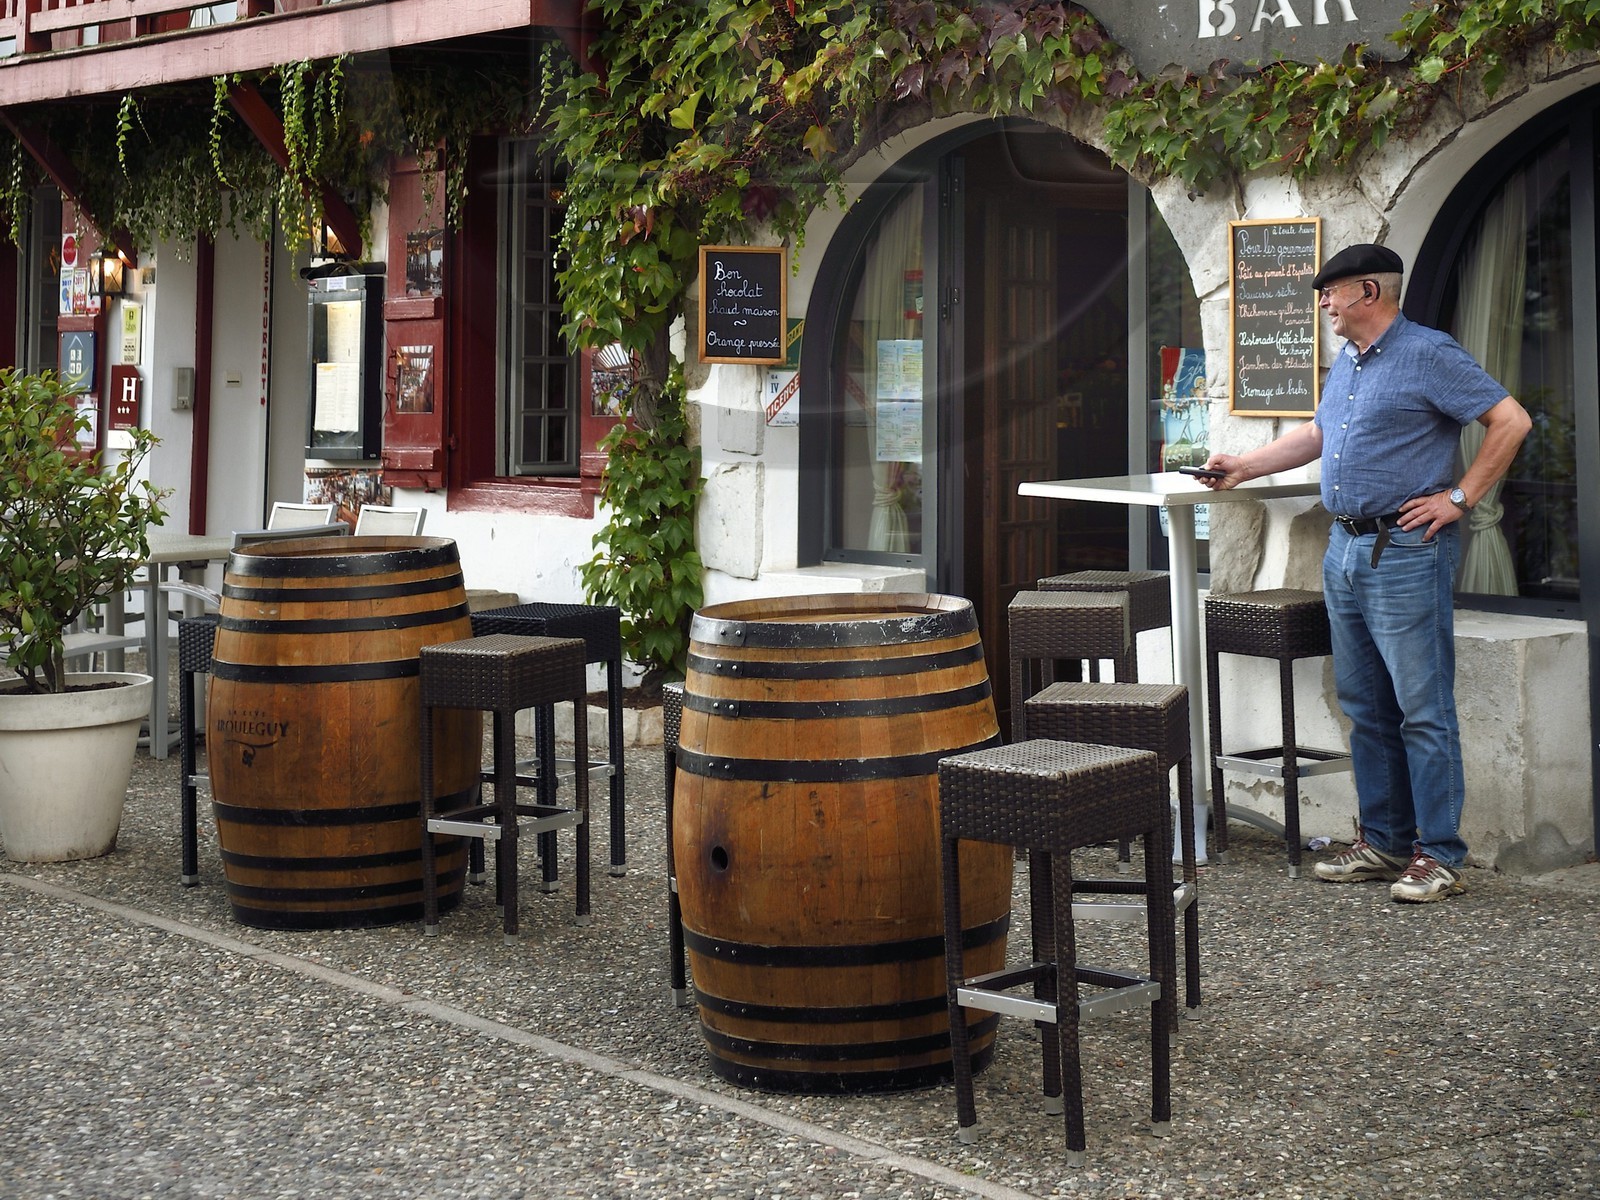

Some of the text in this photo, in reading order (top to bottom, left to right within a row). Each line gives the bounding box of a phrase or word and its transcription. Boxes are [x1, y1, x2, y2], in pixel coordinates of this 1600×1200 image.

[1237, 229, 1262, 255] Pour
[1263, 228, 1276, 254] les
[714, 261, 742, 280] Bon
[1238, 261, 1253, 280] Pâté
[1255, 270, 1263, 278] au
[717, 279, 763, 298] chocolat
[261, 240, 270, 390] RESTAURANT
[709, 298, 780, 317] chaud maison
[1305, 303, 1314, 314] de
[707, 330, 745, 355] Orange
[1239, 354, 1270, 380] Jambon
[122, 377, 137, 402] H
[767, 375, 800, 421] LICENCE
[771, 382, 779, 394] IV
[1240, 377, 1274, 406] Fromage
[1275, 383, 1286, 396] de
